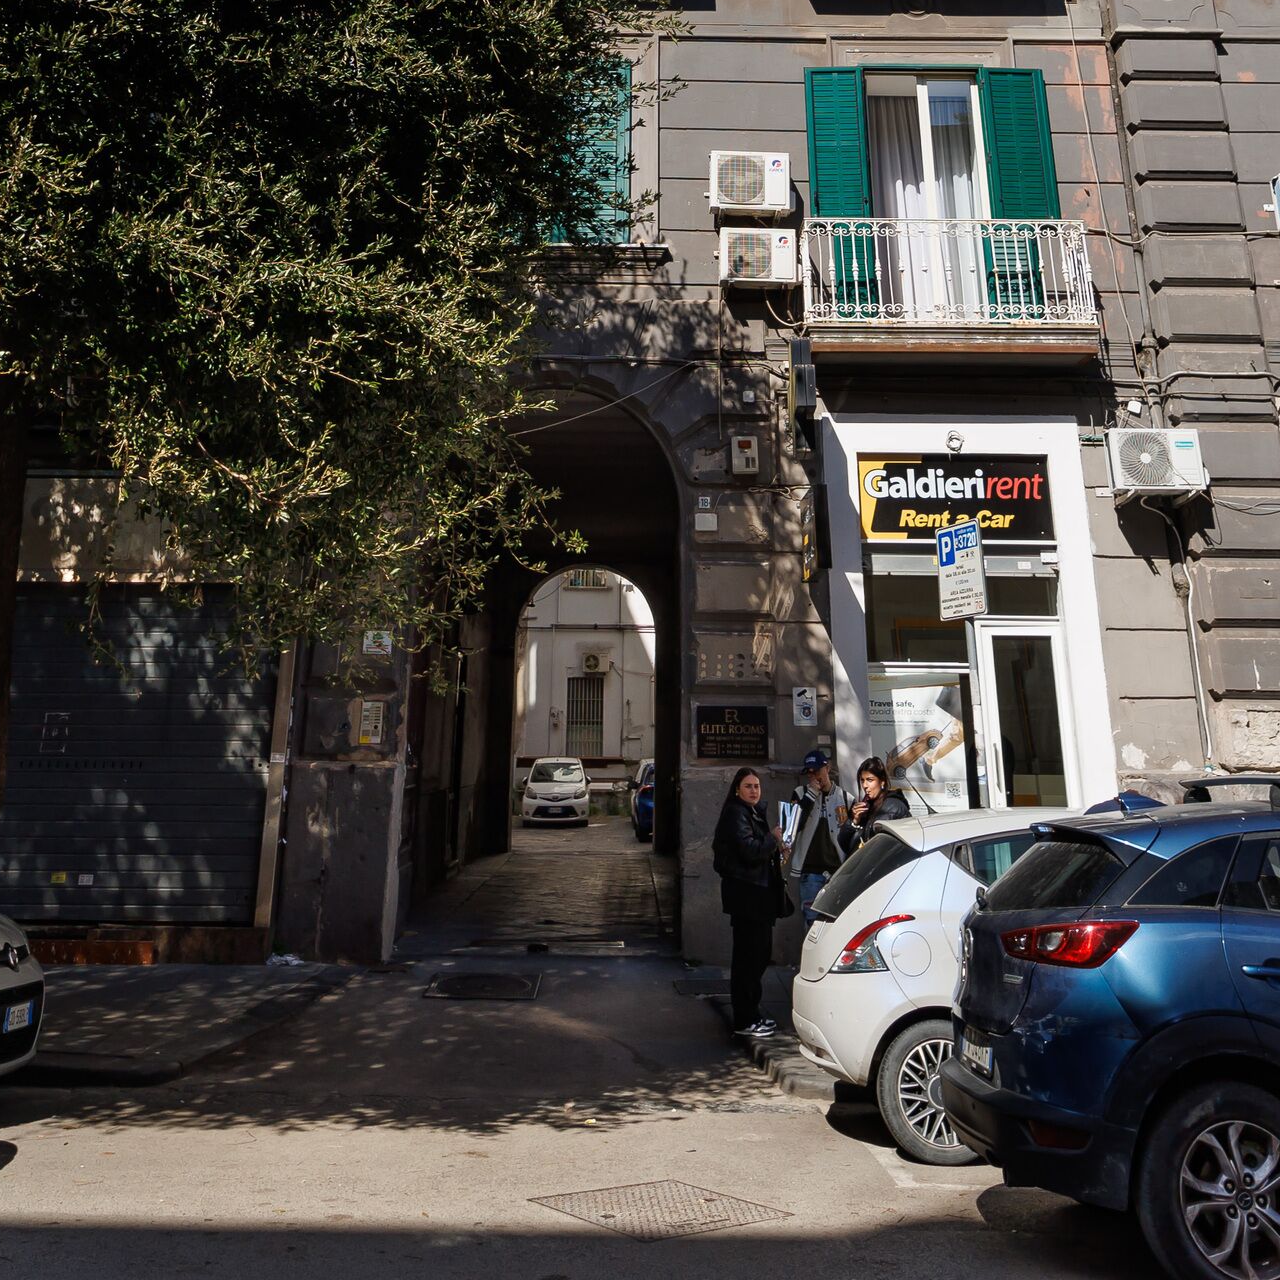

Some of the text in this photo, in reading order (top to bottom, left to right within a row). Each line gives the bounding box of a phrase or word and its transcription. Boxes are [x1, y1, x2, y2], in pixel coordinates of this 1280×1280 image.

[899, 509, 950, 528] Rent
[976, 509, 1016, 529] Car
[941, 532, 977, 563] P 3720
[869, 699, 894, 707] Travel
[728, 724, 766, 735] ROOMS
